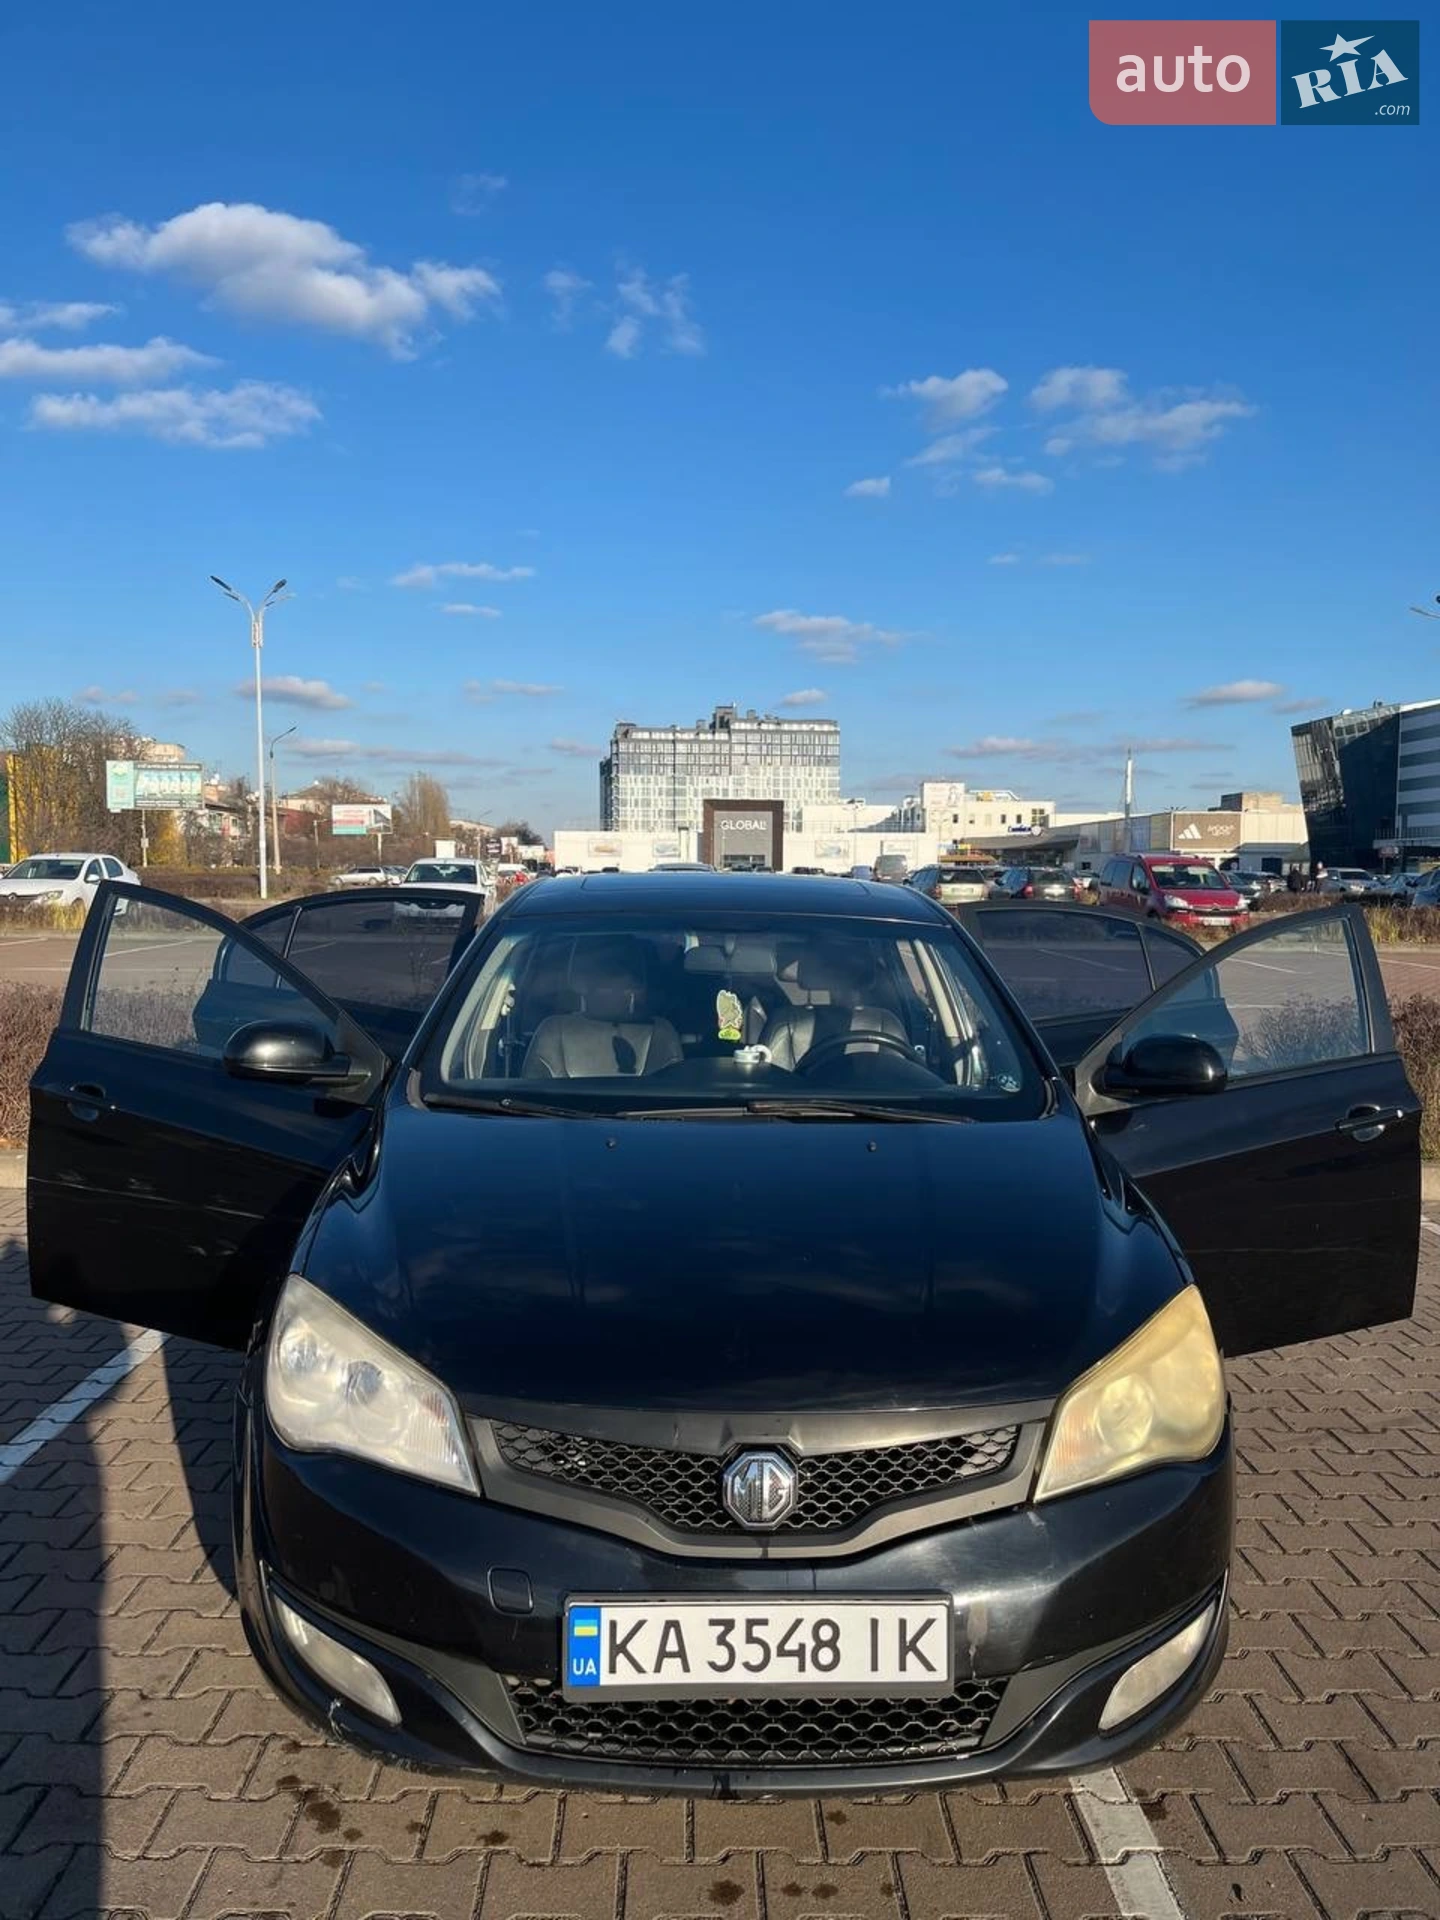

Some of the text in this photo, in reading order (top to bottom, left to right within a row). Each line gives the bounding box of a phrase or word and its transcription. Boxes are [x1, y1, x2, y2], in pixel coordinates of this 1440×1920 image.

[720, 819, 767, 831] GLOBAL
[732, 1461, 790, 1519] MG
[608, 1617, 938, 1676] KA 3548 IK
[572, 1657, 597, 1676] UA
